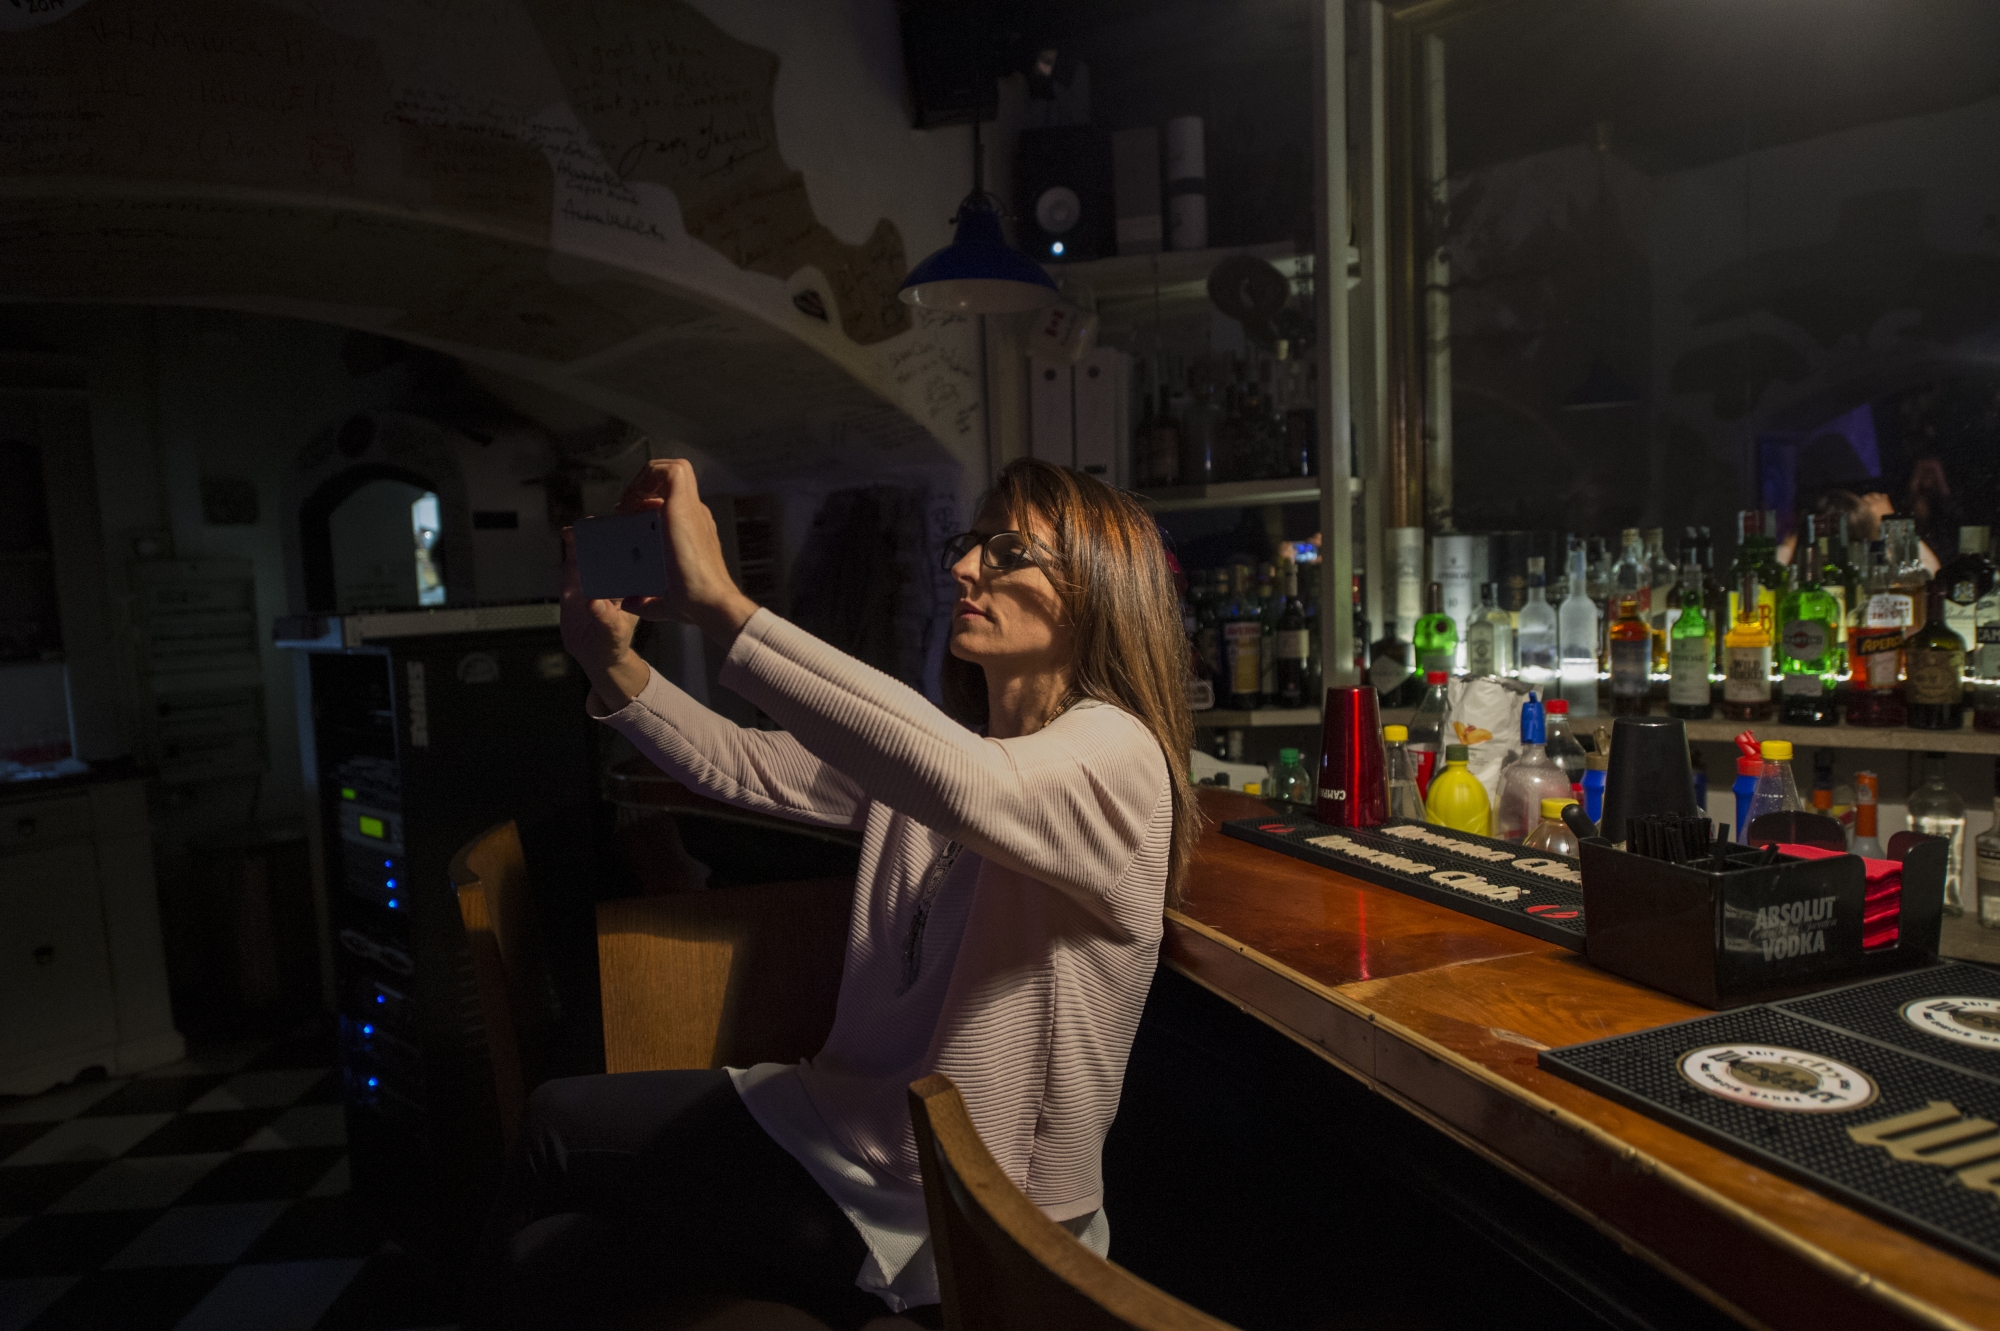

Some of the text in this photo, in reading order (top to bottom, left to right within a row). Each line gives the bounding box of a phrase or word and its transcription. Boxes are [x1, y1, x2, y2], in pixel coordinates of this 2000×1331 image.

[1729, 667, 1765, 680] TURKEY
[1732, 659, 1761, 669] WILD
[1754, 895, 1837, 931] ABSOLUT
[1761, 929, 1826, 962] VODKA
